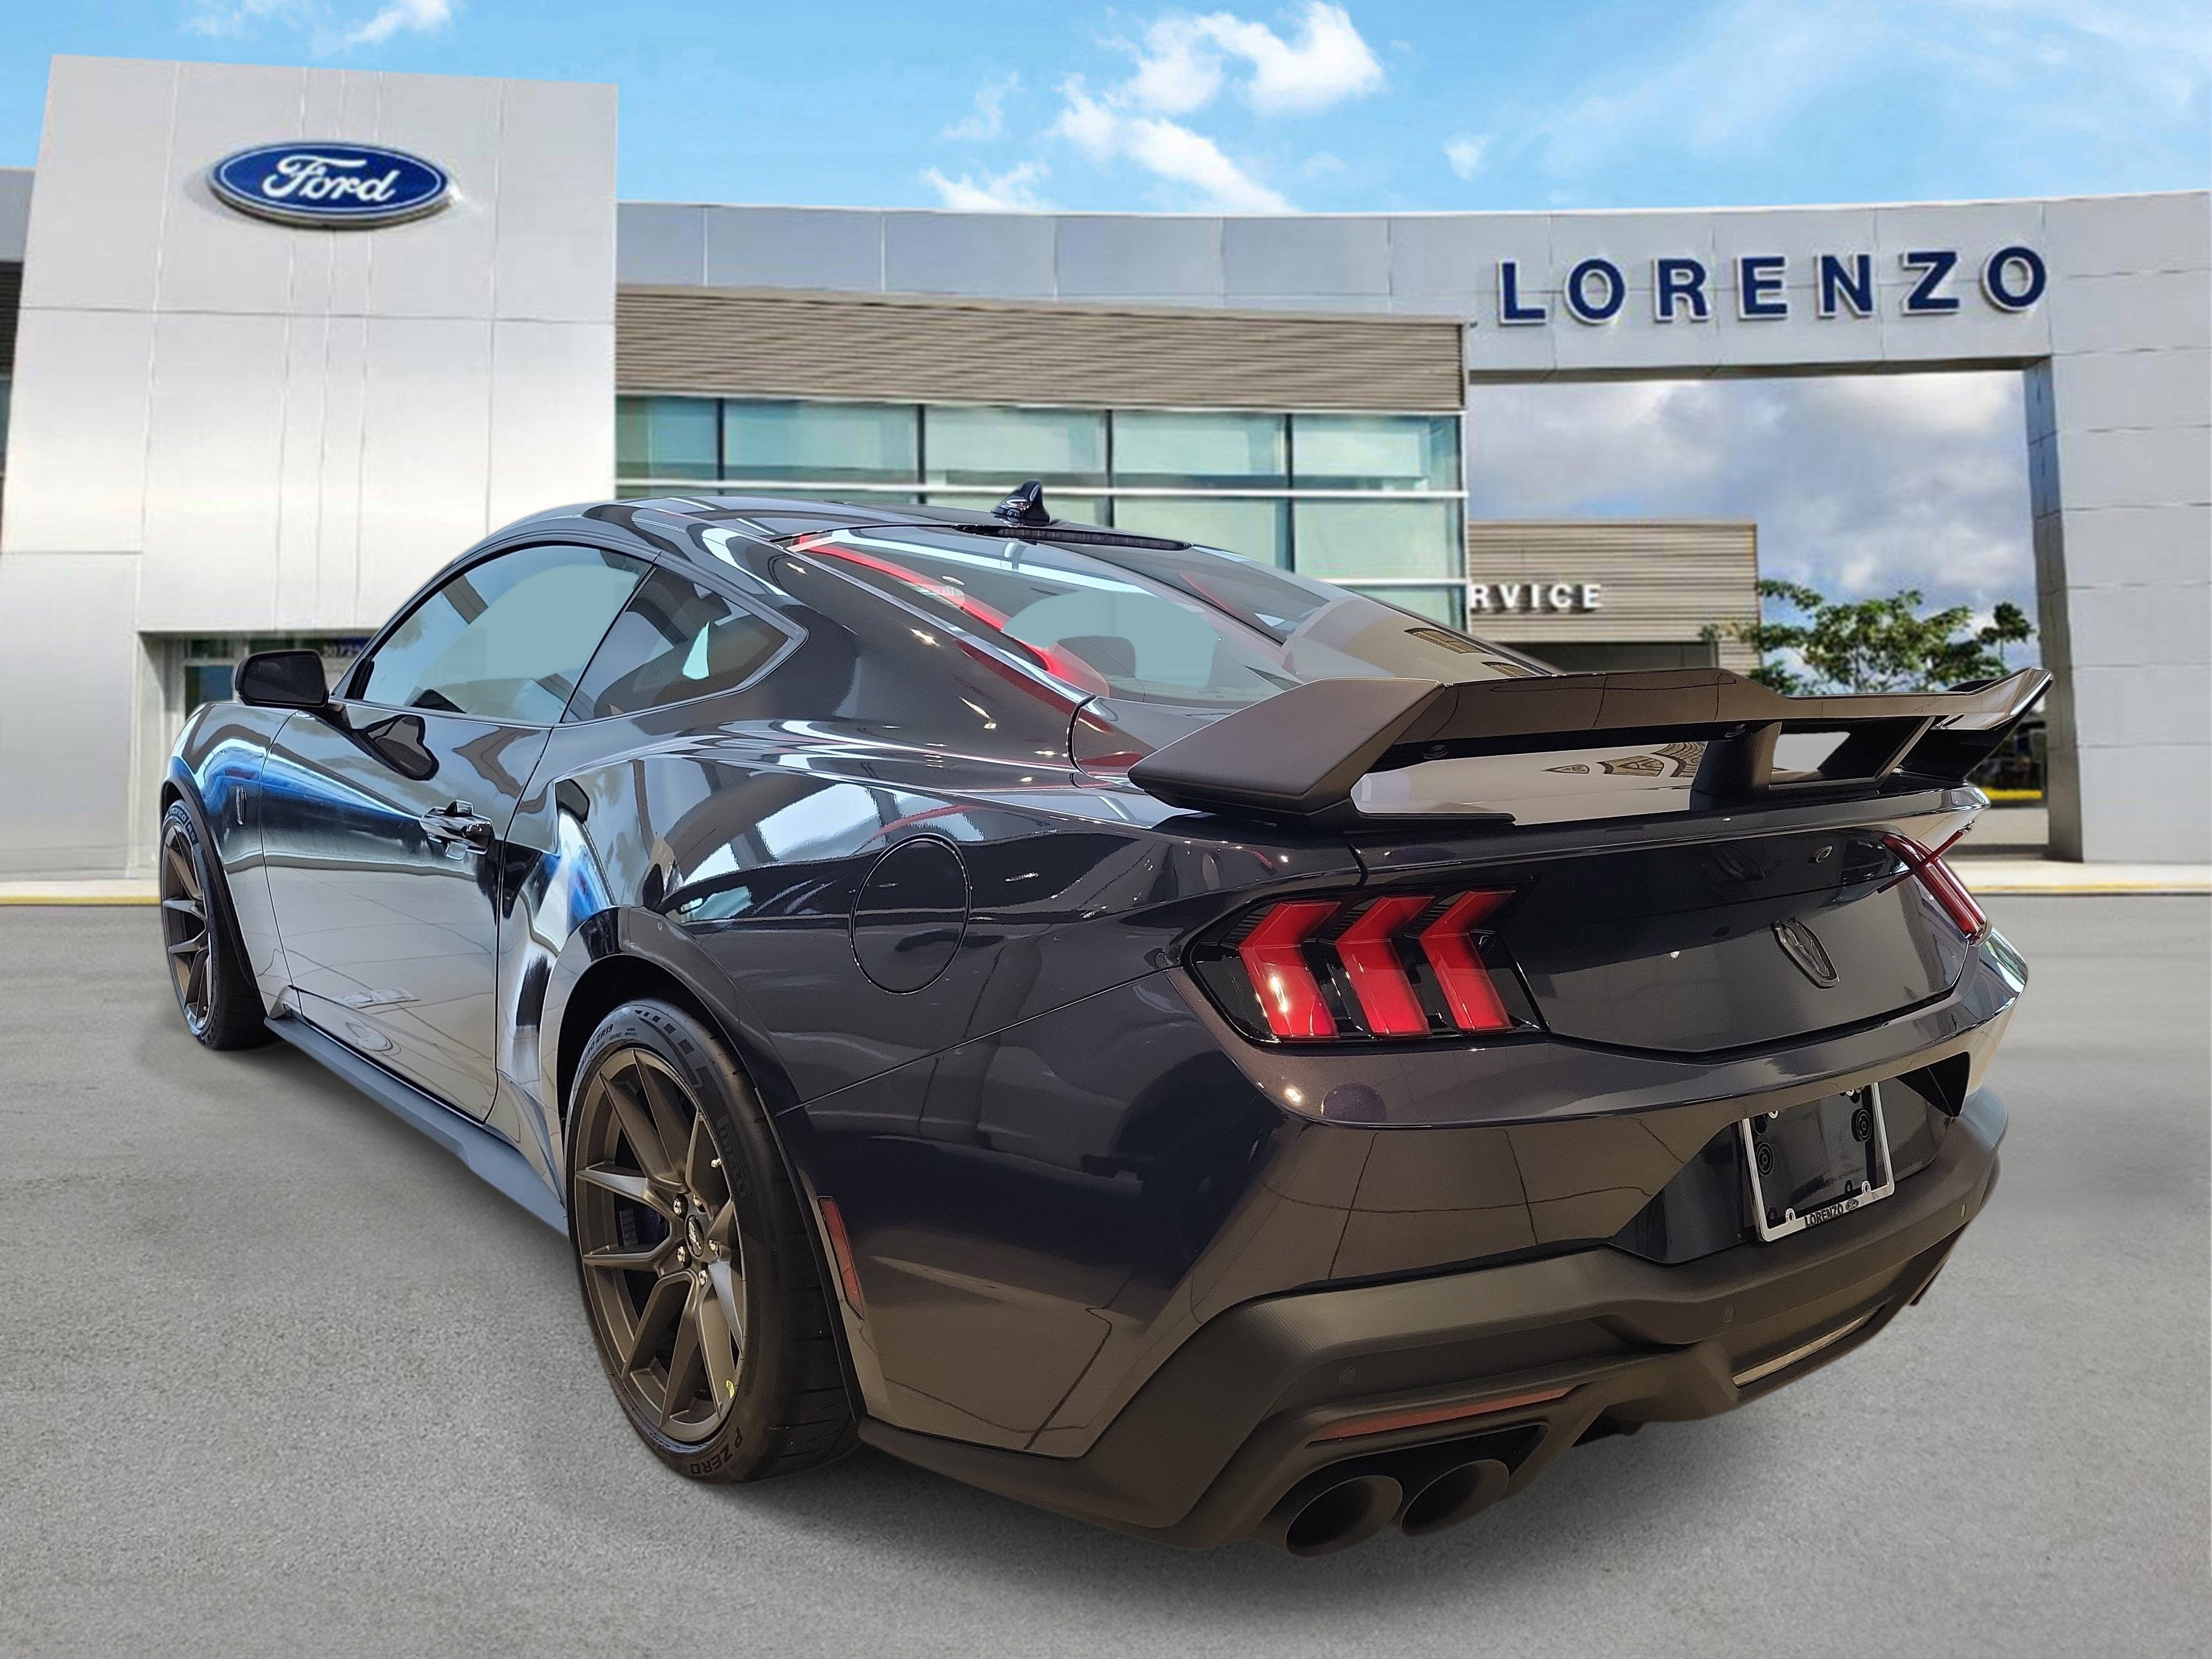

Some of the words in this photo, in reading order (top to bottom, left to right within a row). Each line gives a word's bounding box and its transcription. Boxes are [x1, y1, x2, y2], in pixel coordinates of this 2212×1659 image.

[262, 154, 401, 202] Ford
[1499, 246, 2047, 323] LORENZO
[596, 1024, 613, 1045] ZR19
[716, 1114, 752, 1199] PIRELLI
[1804, 1203, 1844, 1227] LORENZO
[690, 1443, 733, 1475] ZERO
